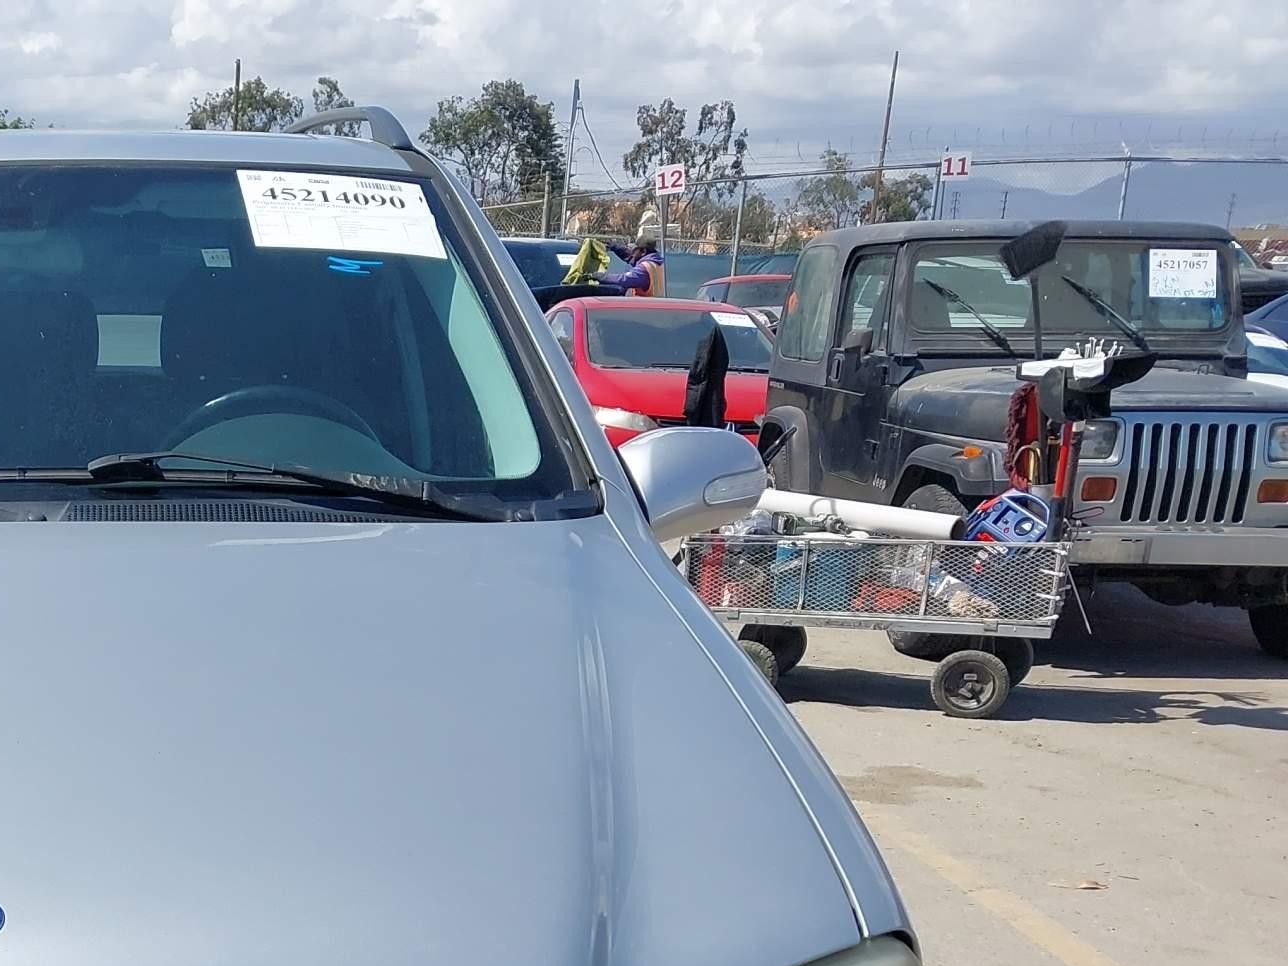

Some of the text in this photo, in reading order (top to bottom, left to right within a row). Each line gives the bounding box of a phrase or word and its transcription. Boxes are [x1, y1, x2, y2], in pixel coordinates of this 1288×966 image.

[942, 156, 969, 176] 11
[657, 170, 683, 190] 12
[262, 187, 406, 209] 45214090
[1156, 259, 1208, 270] 45217057
